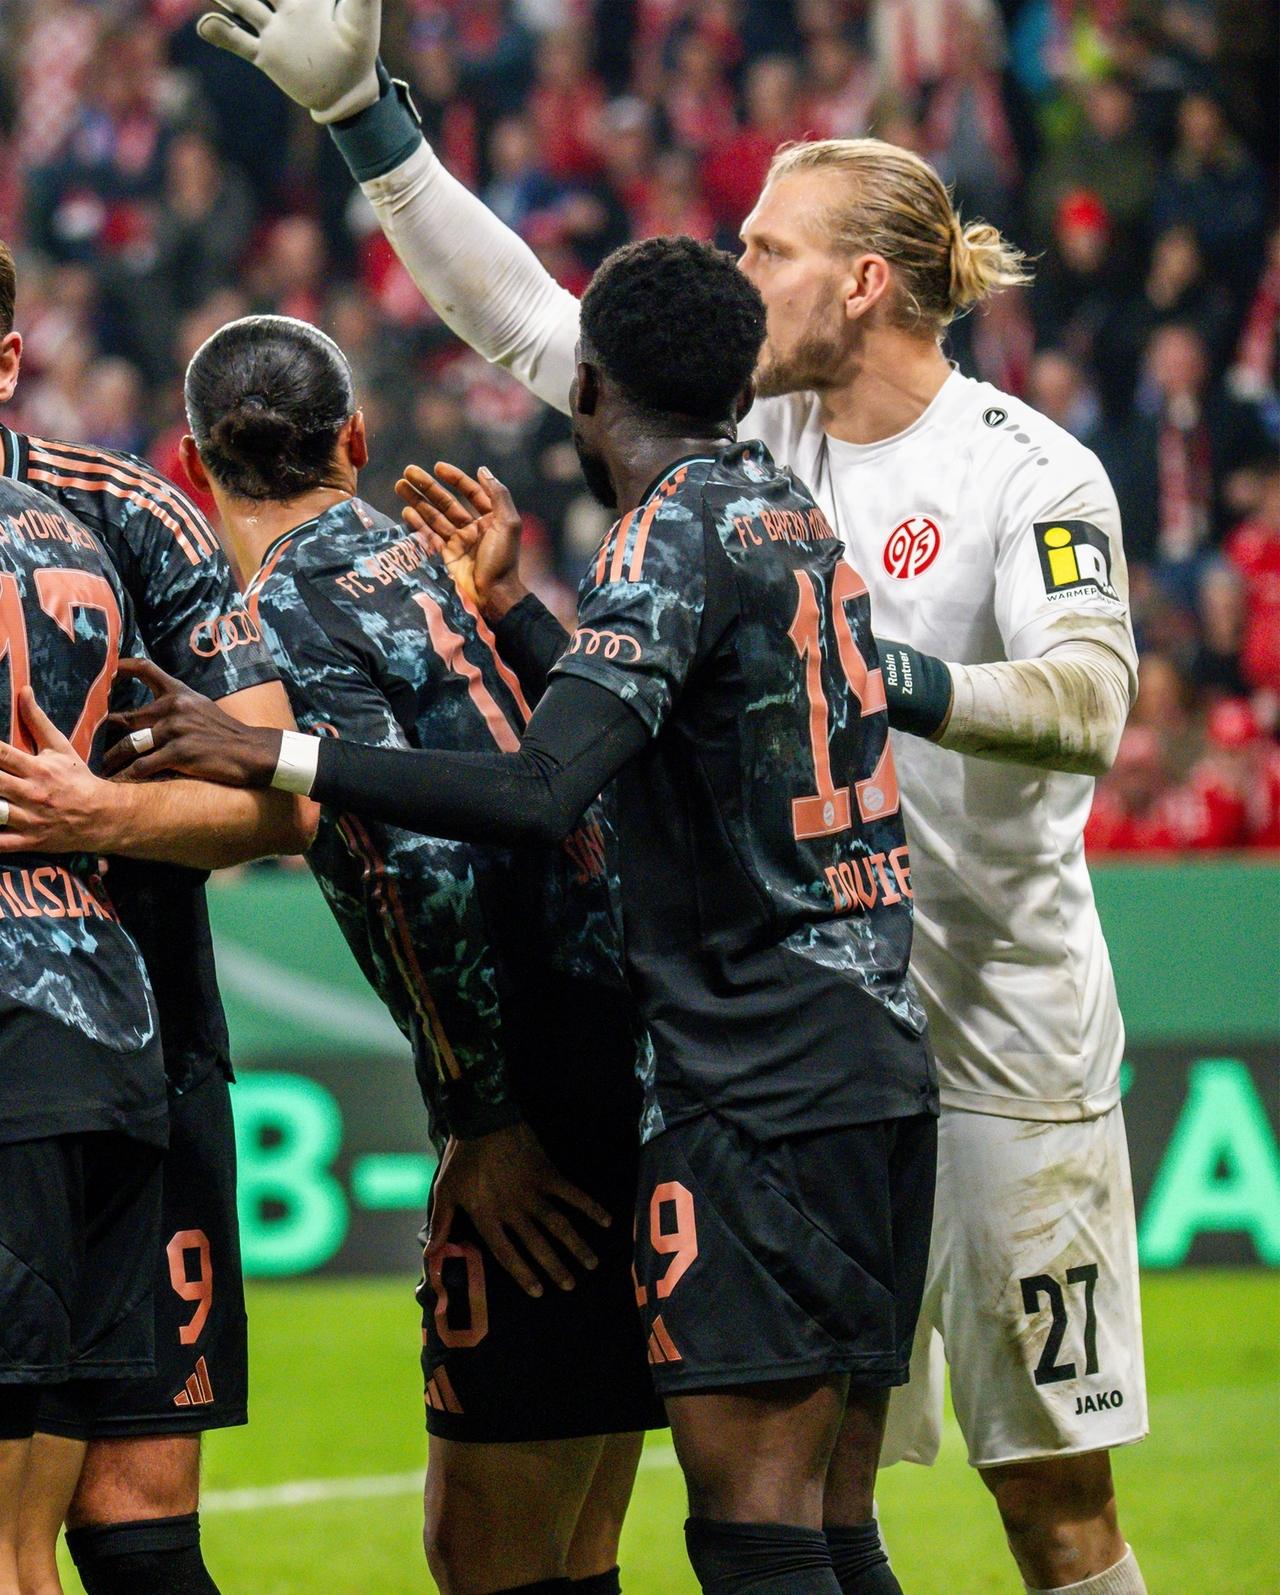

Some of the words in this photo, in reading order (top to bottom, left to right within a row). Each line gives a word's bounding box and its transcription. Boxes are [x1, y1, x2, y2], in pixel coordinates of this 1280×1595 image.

[733, 516, 763, 549] FC
[335, 571, 375, 599] FC
[885, 653, 898, 687] Robin
[899, 650, 913, 696] Zentner
[787, 559, 900, 840] 19
[167, 1229, 214, 1345] 9
[421, 1243, 489, 1348] 0
[1020, 1263, 1099, 1386] 27
[1075, 1389, 1124, 1416] JAKO
